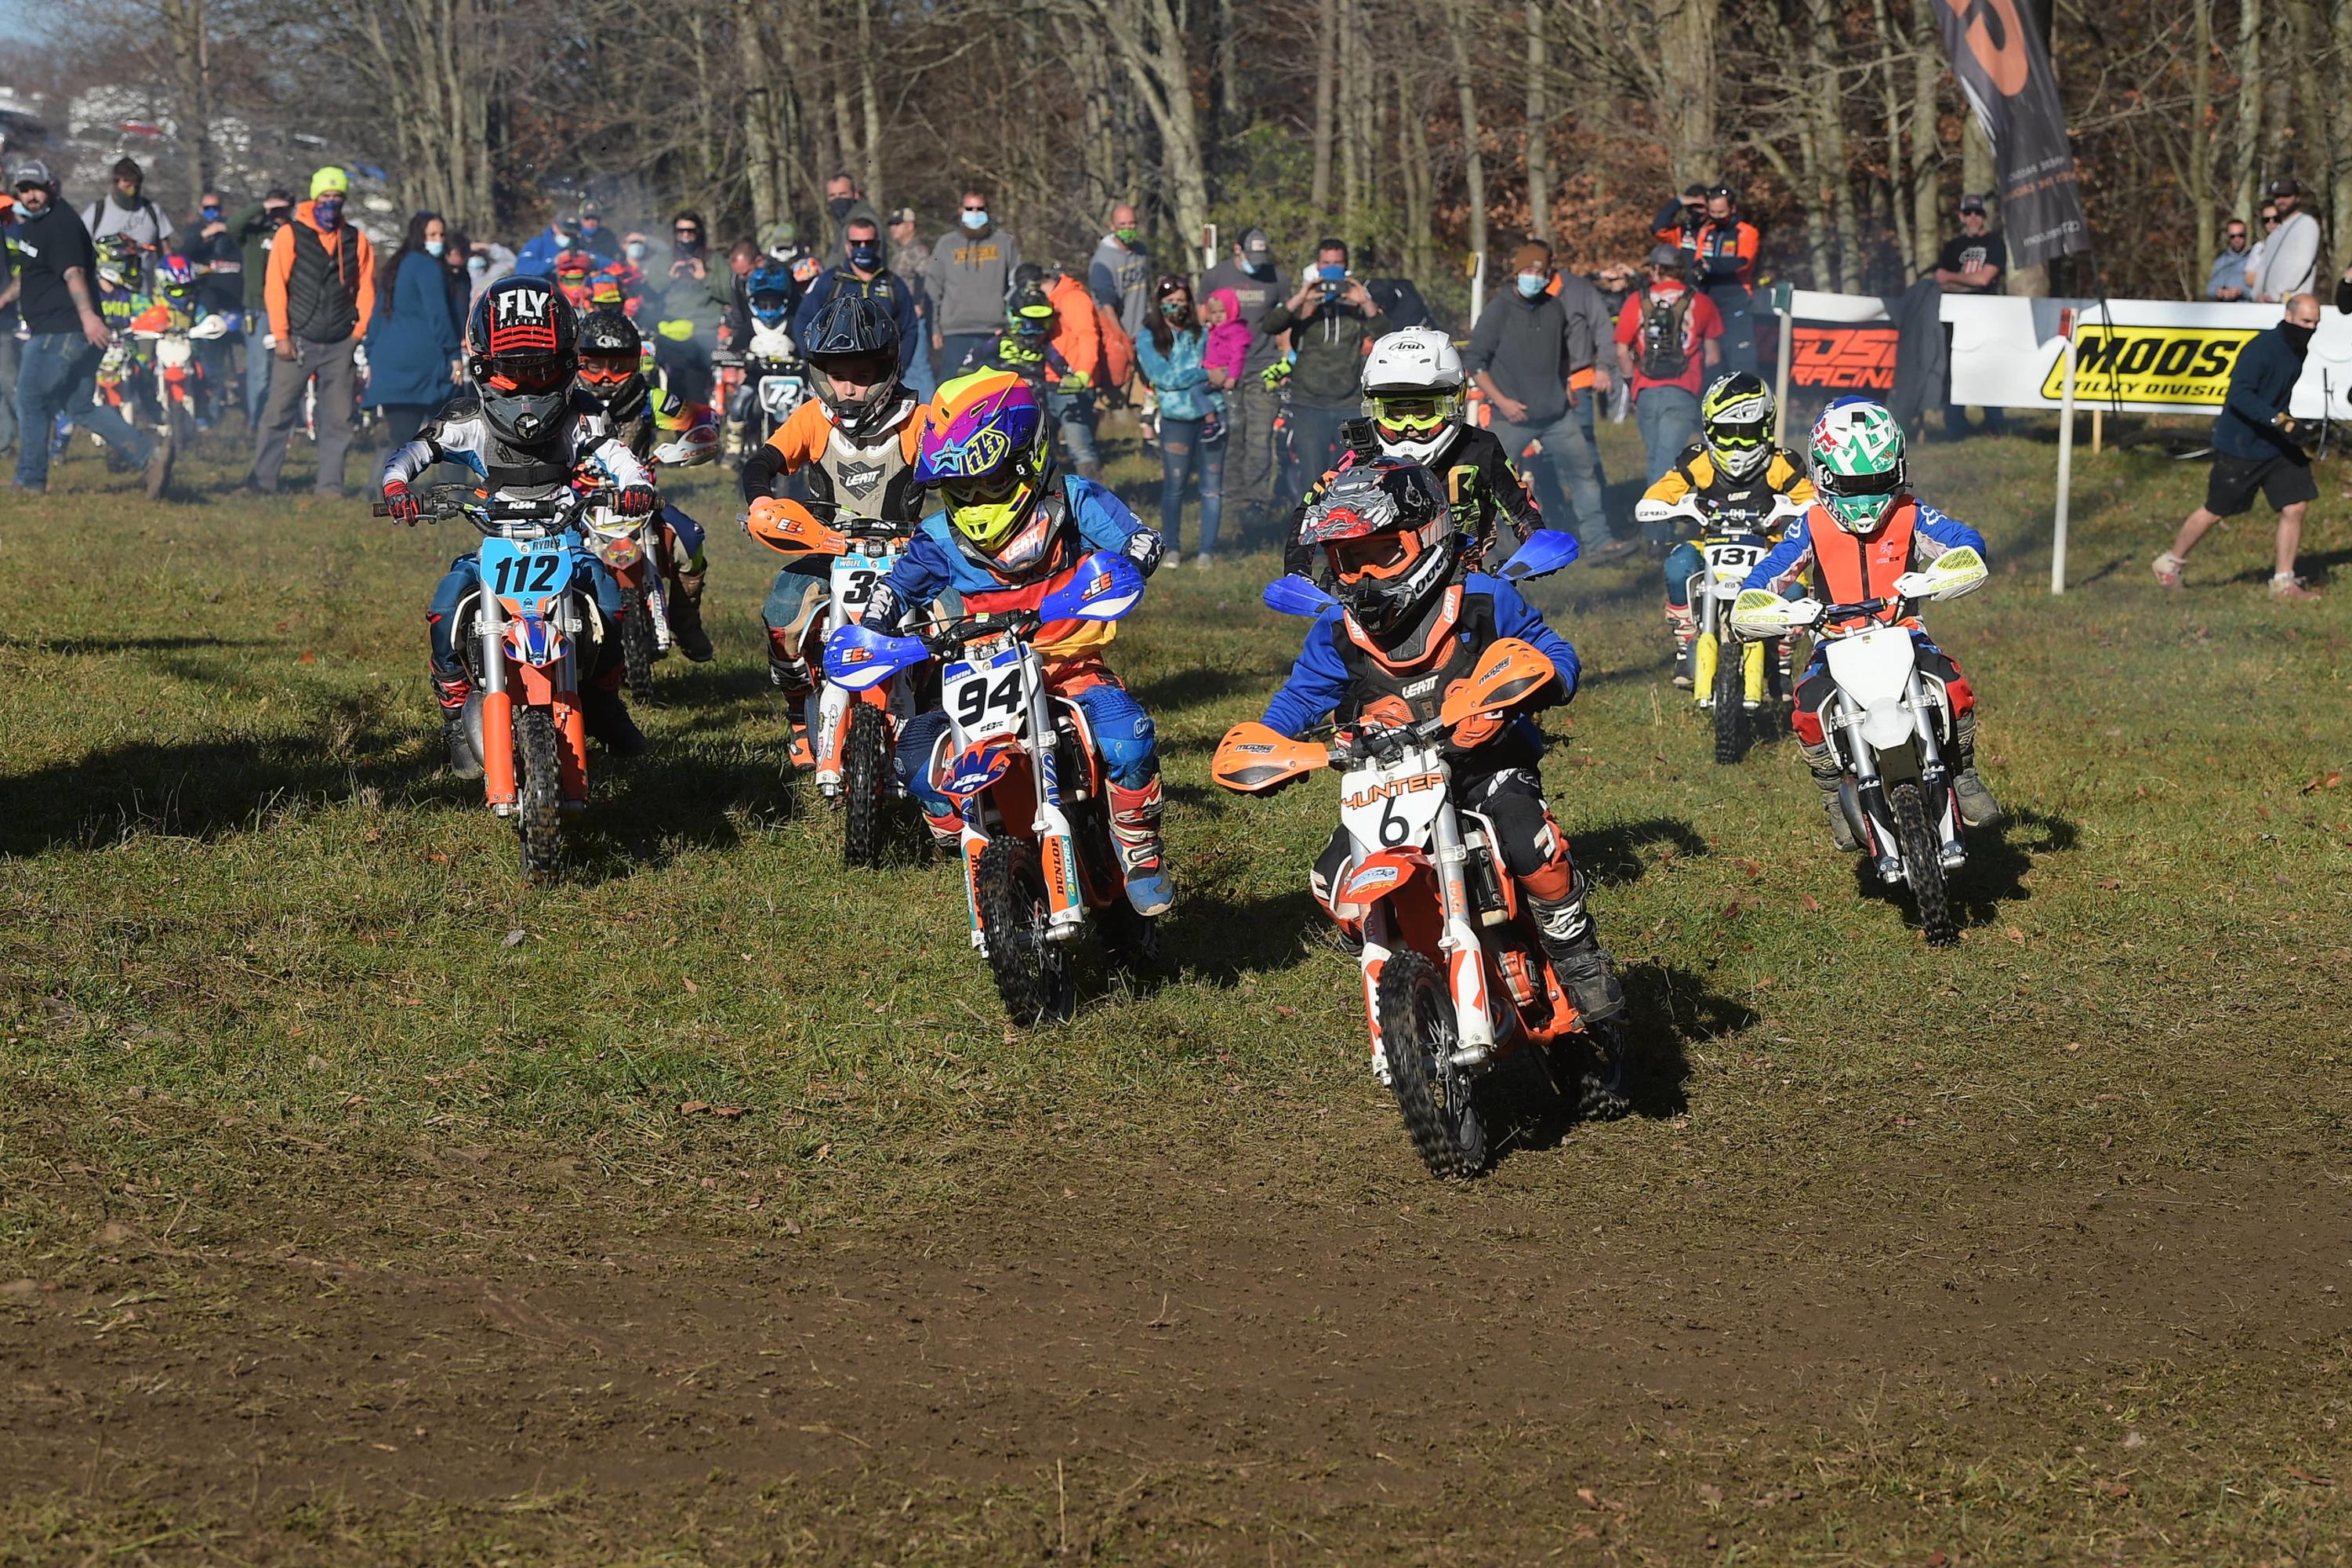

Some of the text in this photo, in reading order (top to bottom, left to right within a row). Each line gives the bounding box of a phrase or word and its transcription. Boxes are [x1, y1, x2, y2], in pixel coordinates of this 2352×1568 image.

[499, 289, 550, 321] FLY
[1388, 341, 1425, 350] Arai
[2076, 336, 2241, 378] MOOS
[766, 383, 798, 405] 72
[845, 470, 881, 488] LEATT
[958, 544, 978, 558] LEATT
[1005, 526, 1040, 561] LEATT
[1711, 547, 1759, 567] 131
[495, 555, 560, 595] 112
[844, 570, 891, 604] 3
[1443, 590, 1456, 624] LEATT
[945, 669, 972, 684] GAVIN
[1402, 675, 1439, 699] LEATT
[958, 668, 1022, 728] 94
[951, 773, 989, 790] KTM
[1341, 773, 1444, 810] HUNTER
[1379, 795, 1410, 848] 6
[1051, 837, 1065, 896] DUNLOP
[1062, 837, 1074, 884] MOTOREX
